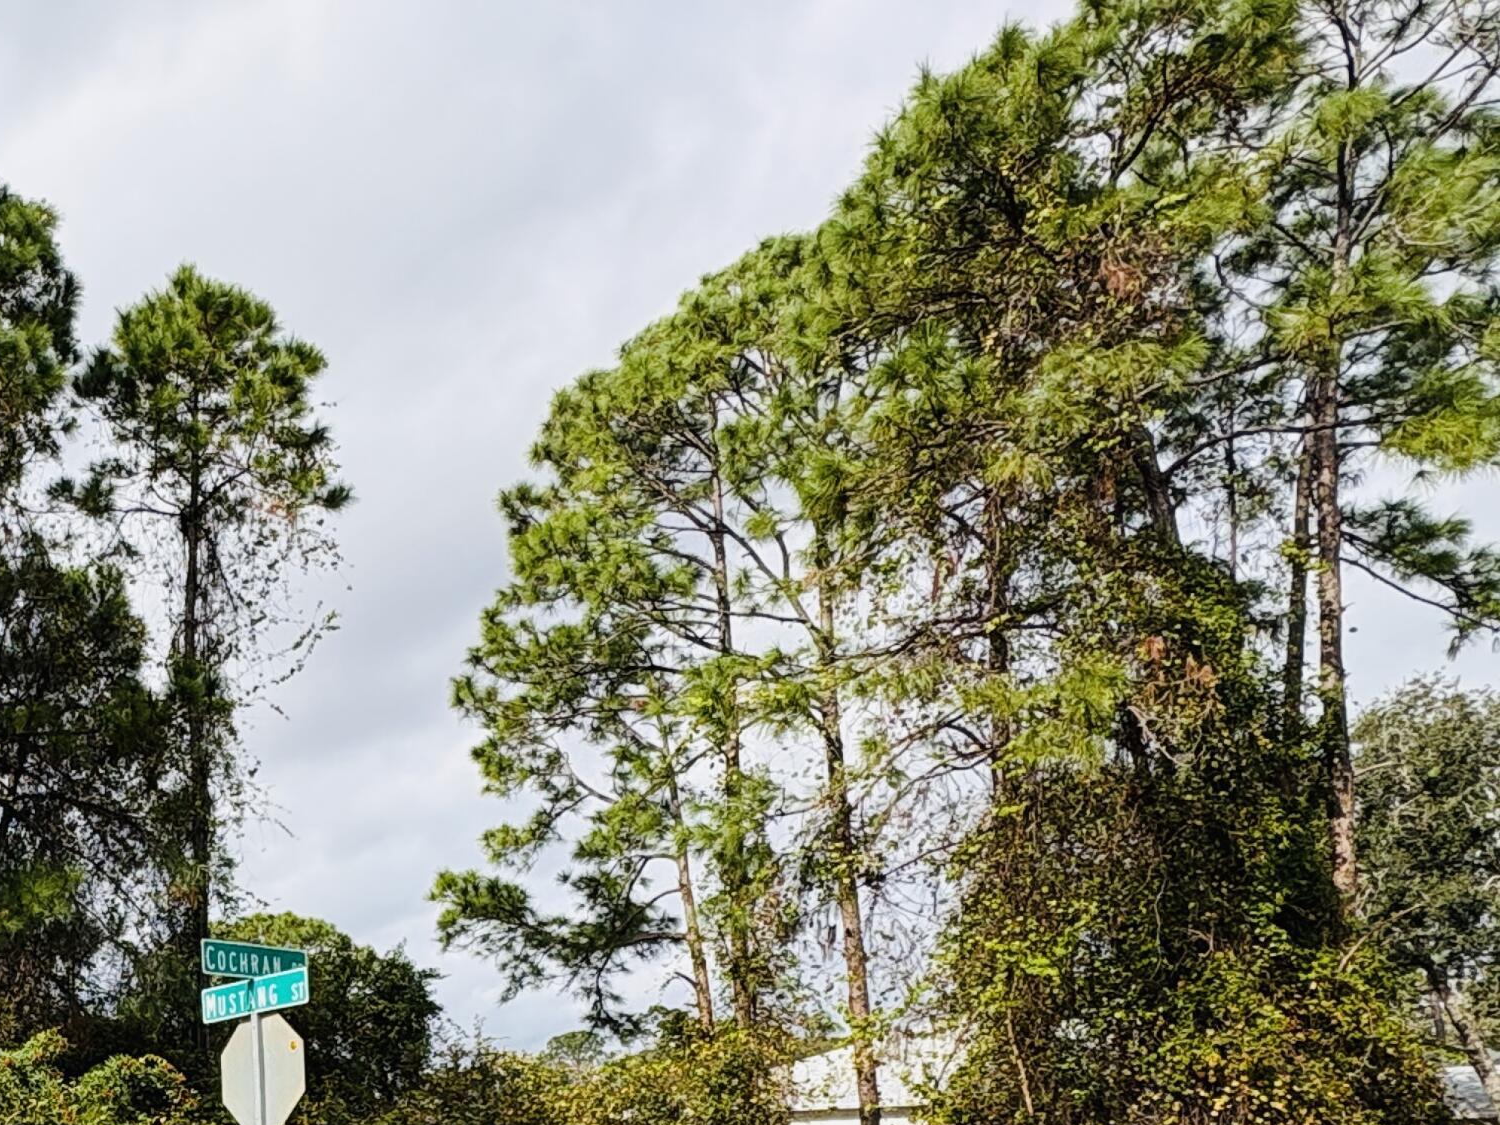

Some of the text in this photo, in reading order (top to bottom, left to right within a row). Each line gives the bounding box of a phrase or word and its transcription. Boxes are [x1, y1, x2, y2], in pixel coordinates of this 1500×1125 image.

[205, 945, 282, 974] COCHRAN
[205, 981, 305, 1019] MUSTANG ST
